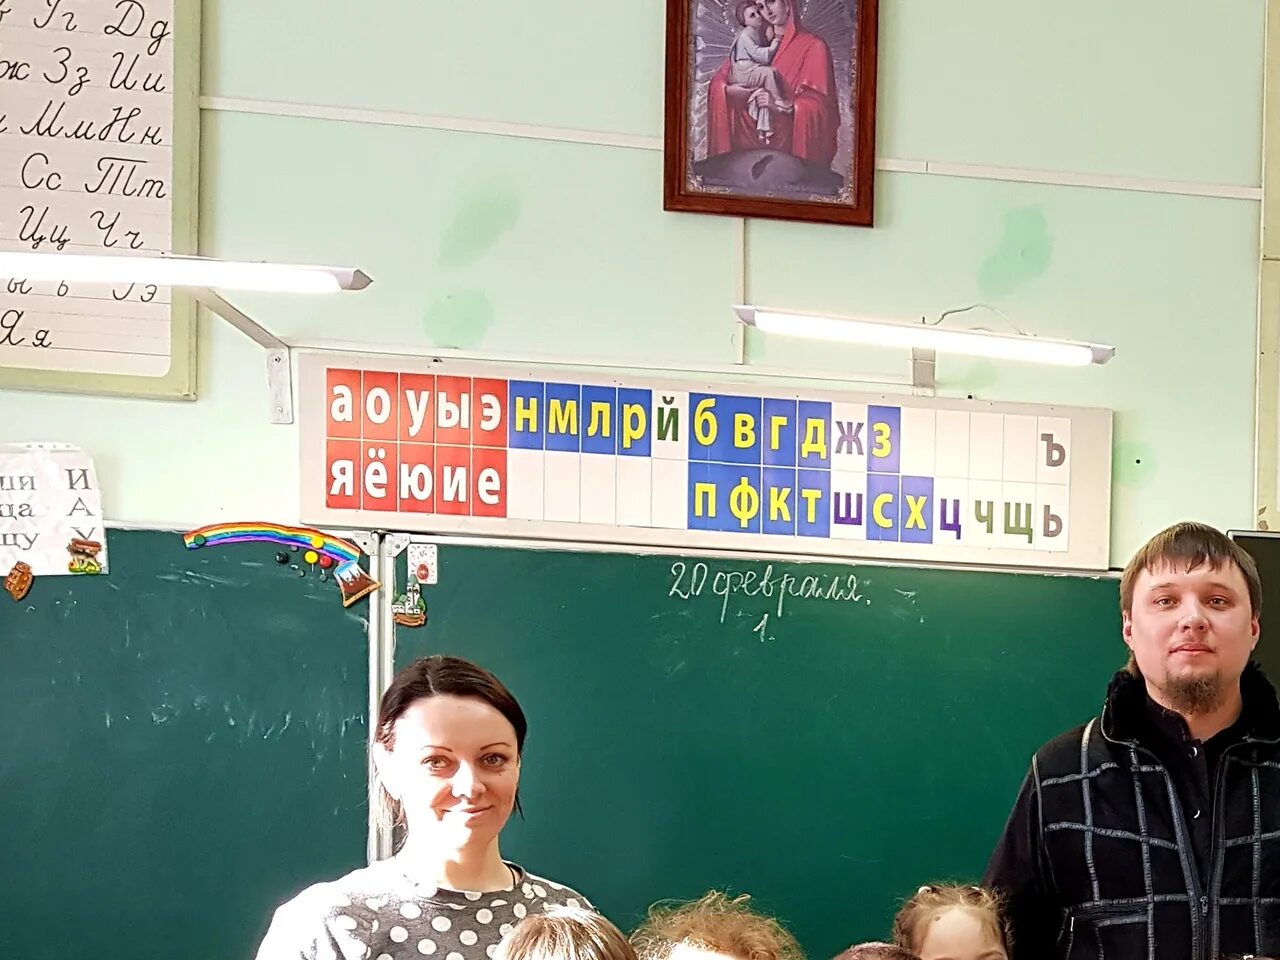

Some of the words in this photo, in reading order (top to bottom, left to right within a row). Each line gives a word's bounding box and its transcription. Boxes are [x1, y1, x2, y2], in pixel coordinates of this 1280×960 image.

[104, 0, 171, 55] Дд
[44, 47, 90, 96] Зз
[110, 52, 165, 92] Ии
[21, 152, 62, 190] Сс
[85, 156, 166, 198] Тт
[19, 206, 71, 250] Цц
[90, 210, 144, 250] Чч
[65, 468, 91, 490] И
[66, 497, 95, 516] А
[669, 562, 707, 599] 20
